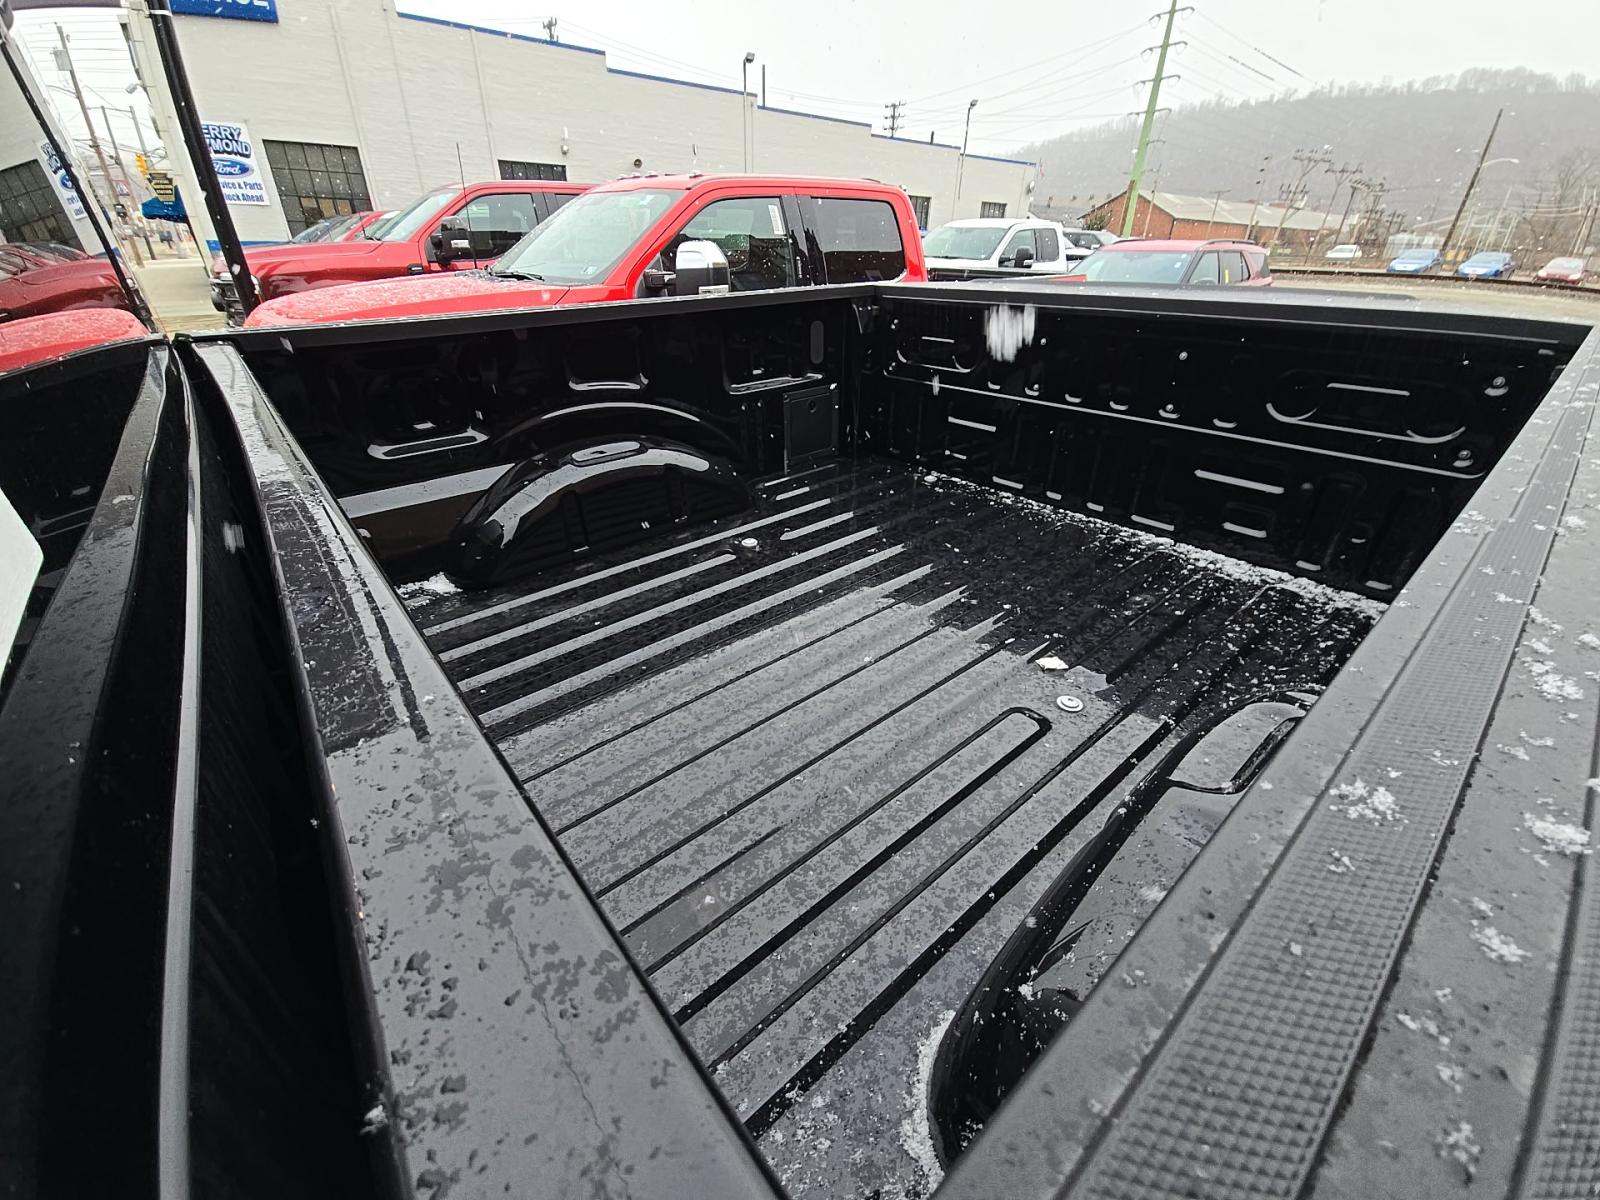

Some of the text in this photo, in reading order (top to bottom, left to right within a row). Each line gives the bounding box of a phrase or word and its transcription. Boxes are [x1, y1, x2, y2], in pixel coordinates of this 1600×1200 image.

[202, 124, 241, 140] ERRY
[206, 138, 252, 158] MOND
[220, 181, 236, 190] vice
[244, 181, 263, 191] Parts
[224, 192, 265, 203] lock Ahead
